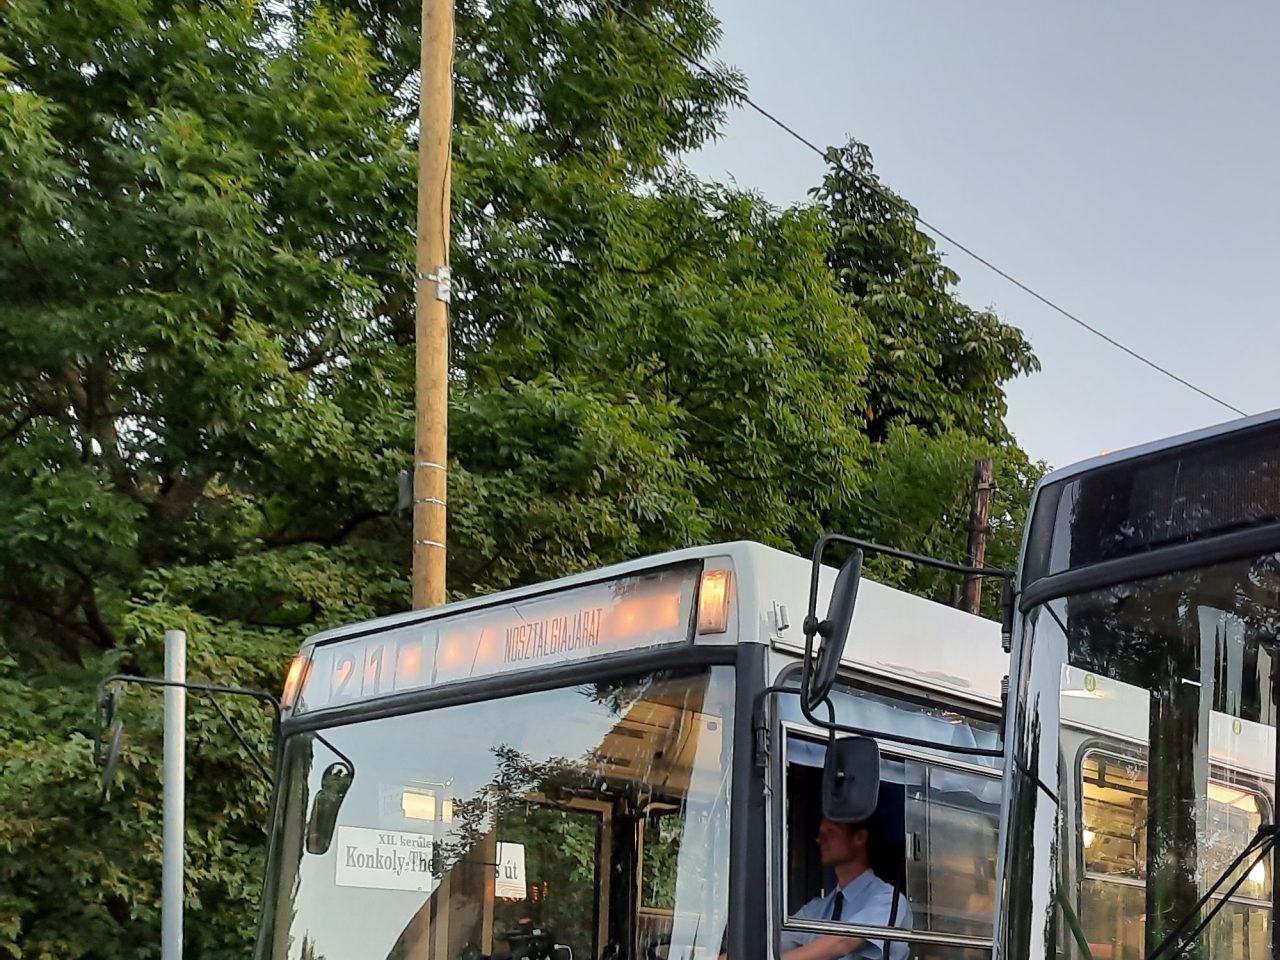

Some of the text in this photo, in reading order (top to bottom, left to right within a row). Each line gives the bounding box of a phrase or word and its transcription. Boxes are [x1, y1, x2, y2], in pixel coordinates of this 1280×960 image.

[335, 645, 385, 698] 21
[400, 834, 433, 848] kerüle
[345, 845, 433, 876] Konkoly-The
